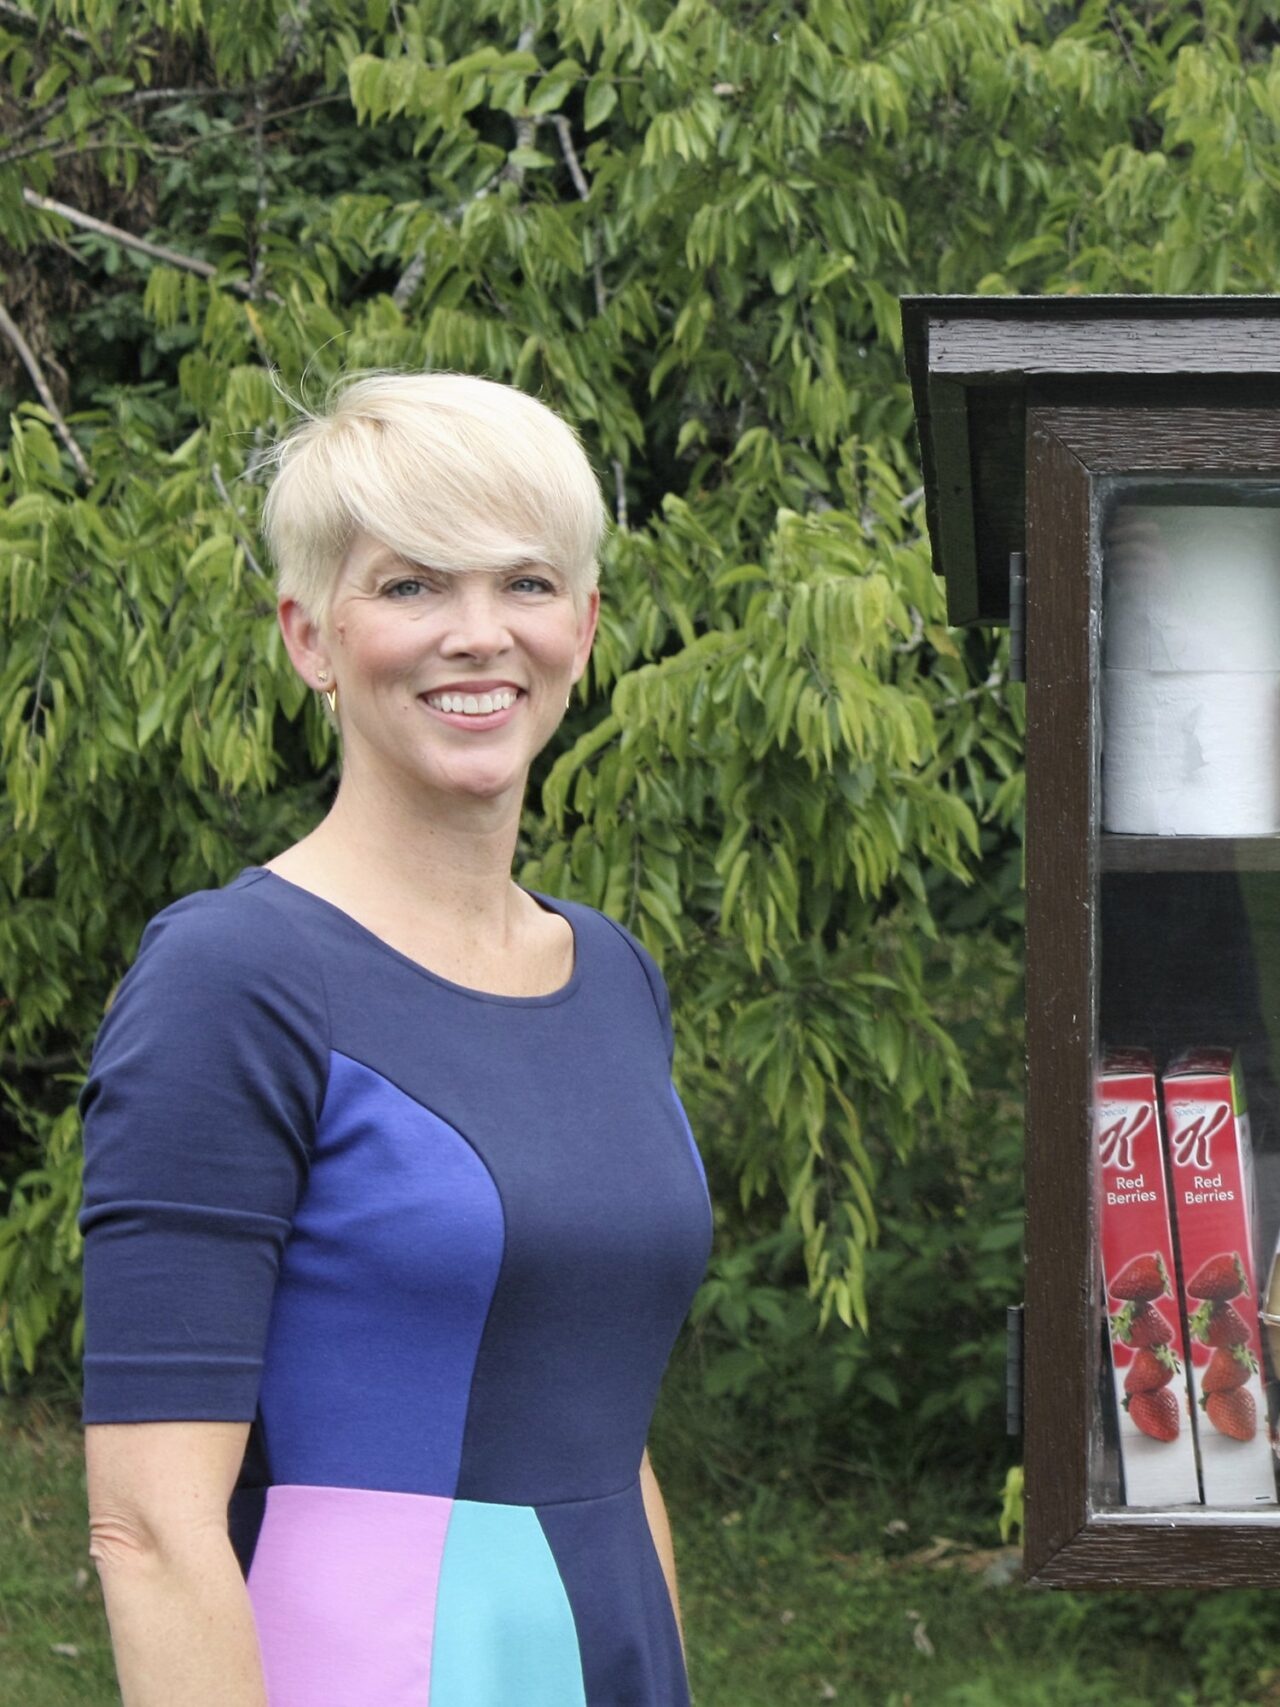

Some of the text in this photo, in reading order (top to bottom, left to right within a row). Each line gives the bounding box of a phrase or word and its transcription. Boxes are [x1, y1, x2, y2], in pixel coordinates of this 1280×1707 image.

[1174, 1104, 1229, 1168] K
[1116, 1174, 1144, 1190] Red
[1194, 1173, 1222, 1189] Red
[1107, 1190, 1157, 1205] Berries
[1185, 1189, 1235, 1205] Berries
